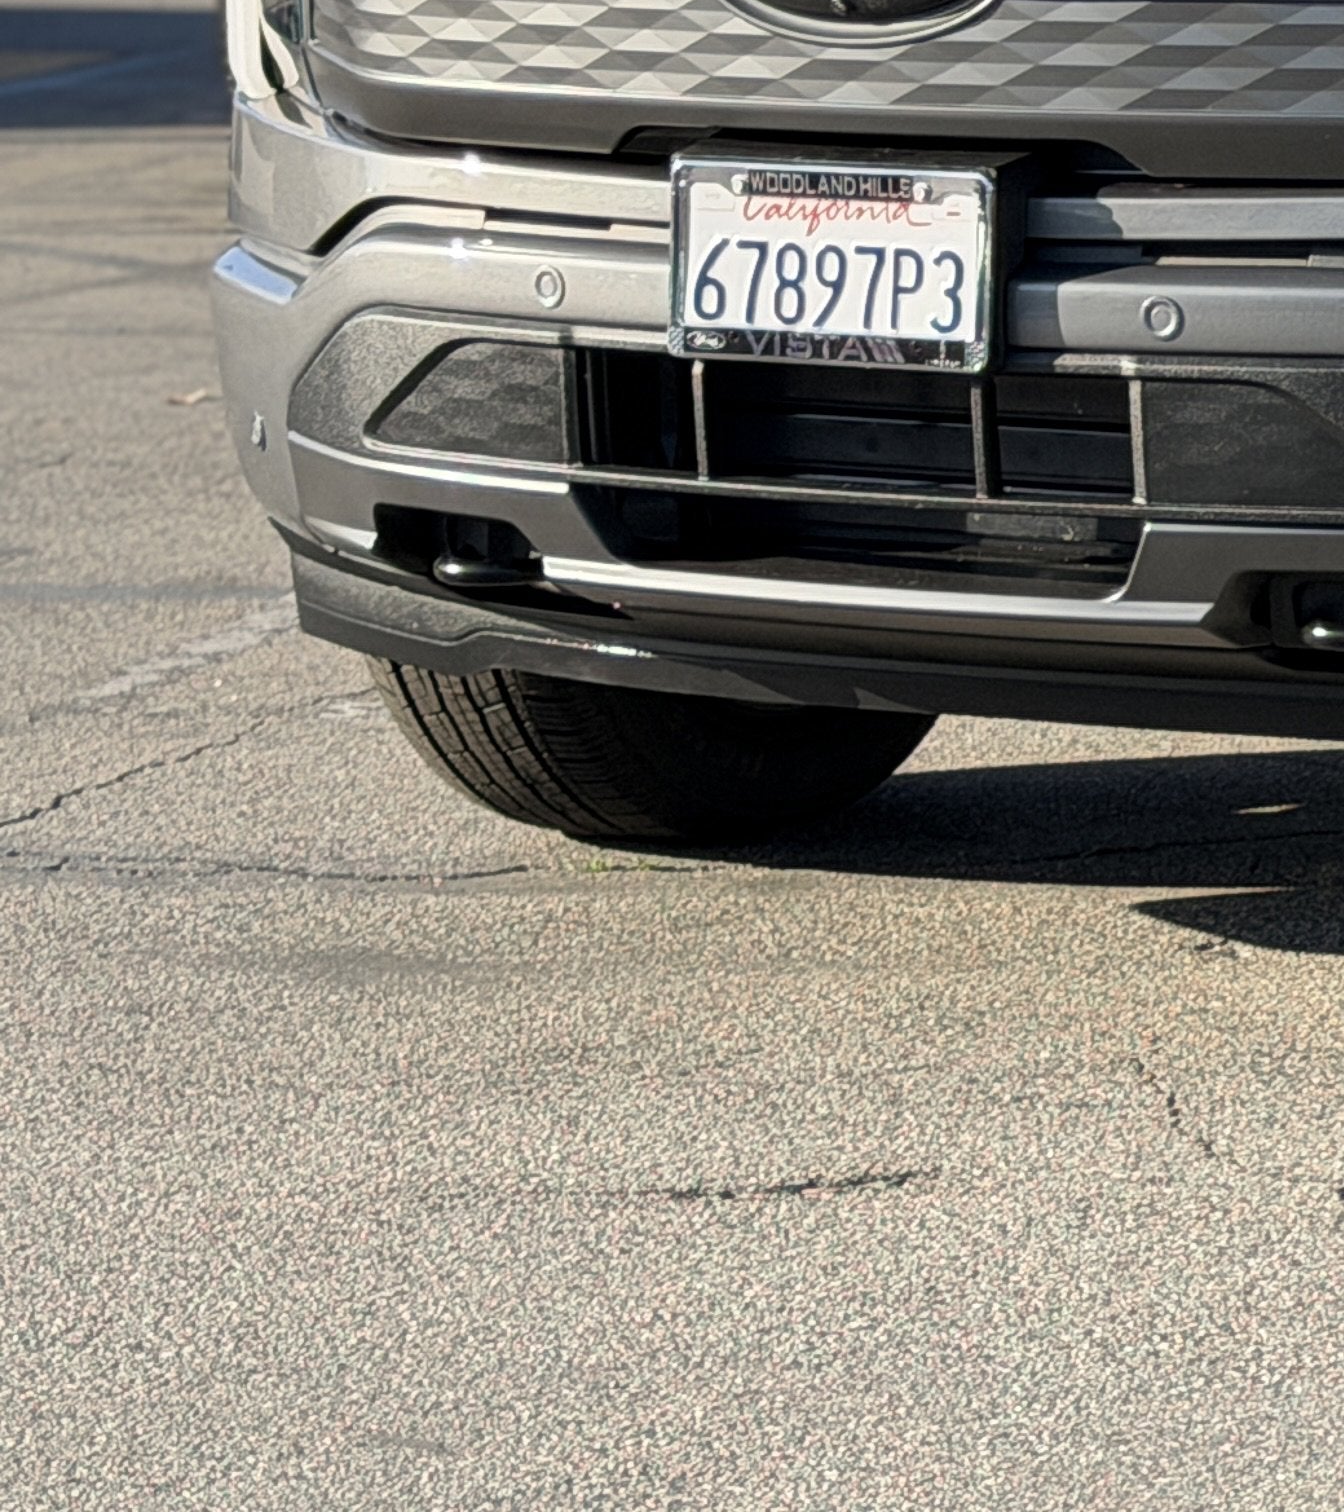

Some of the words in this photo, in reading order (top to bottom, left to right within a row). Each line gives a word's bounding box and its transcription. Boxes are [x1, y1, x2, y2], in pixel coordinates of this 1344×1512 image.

[750, 173, 858, 197] WOODLAND
[858, 178, 912, 199] HILLS
[742, 196, 932, 237] California
[693, 237, 965, 334] 67897P3
[745, 330, 868, 362] VISTA
